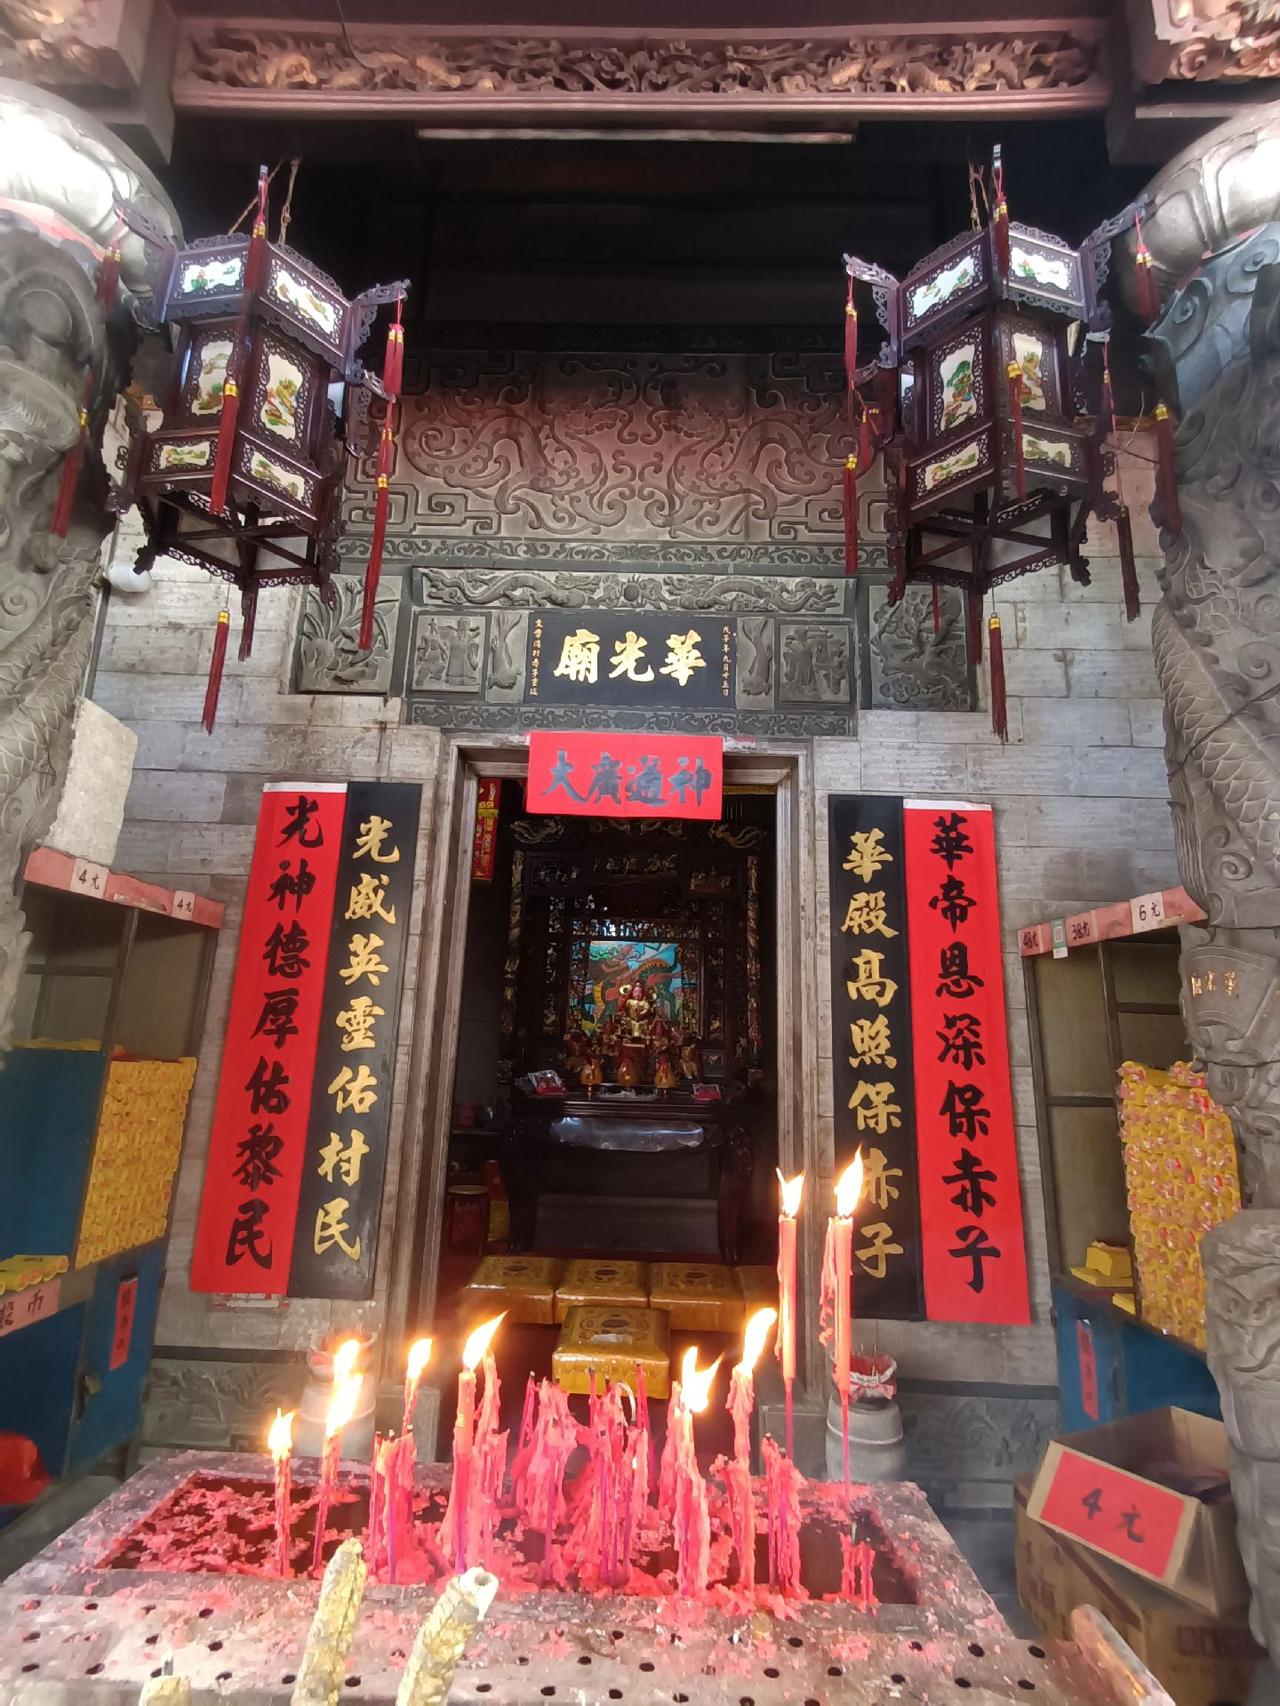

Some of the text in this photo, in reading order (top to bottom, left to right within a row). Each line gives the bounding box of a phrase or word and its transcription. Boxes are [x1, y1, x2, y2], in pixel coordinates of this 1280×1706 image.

[553, 629, 707, 686] 華光廟
[541, 749, 712, 808] 神通廣大
[78, 869, 100, 890] 4元
[1139, 902, 1161, 921] 6元
[225, 795, 325, 1270] 光神德厚佑黎民
[312, 815, 400, 1262] 光威英靈佑村民
[841, 828, 903, 1279] 華殿高照保赤子
[928, 813, 1001, 1293] 華帝恩深保赤子
[1080, 1487, 1145, 1544] 4元
